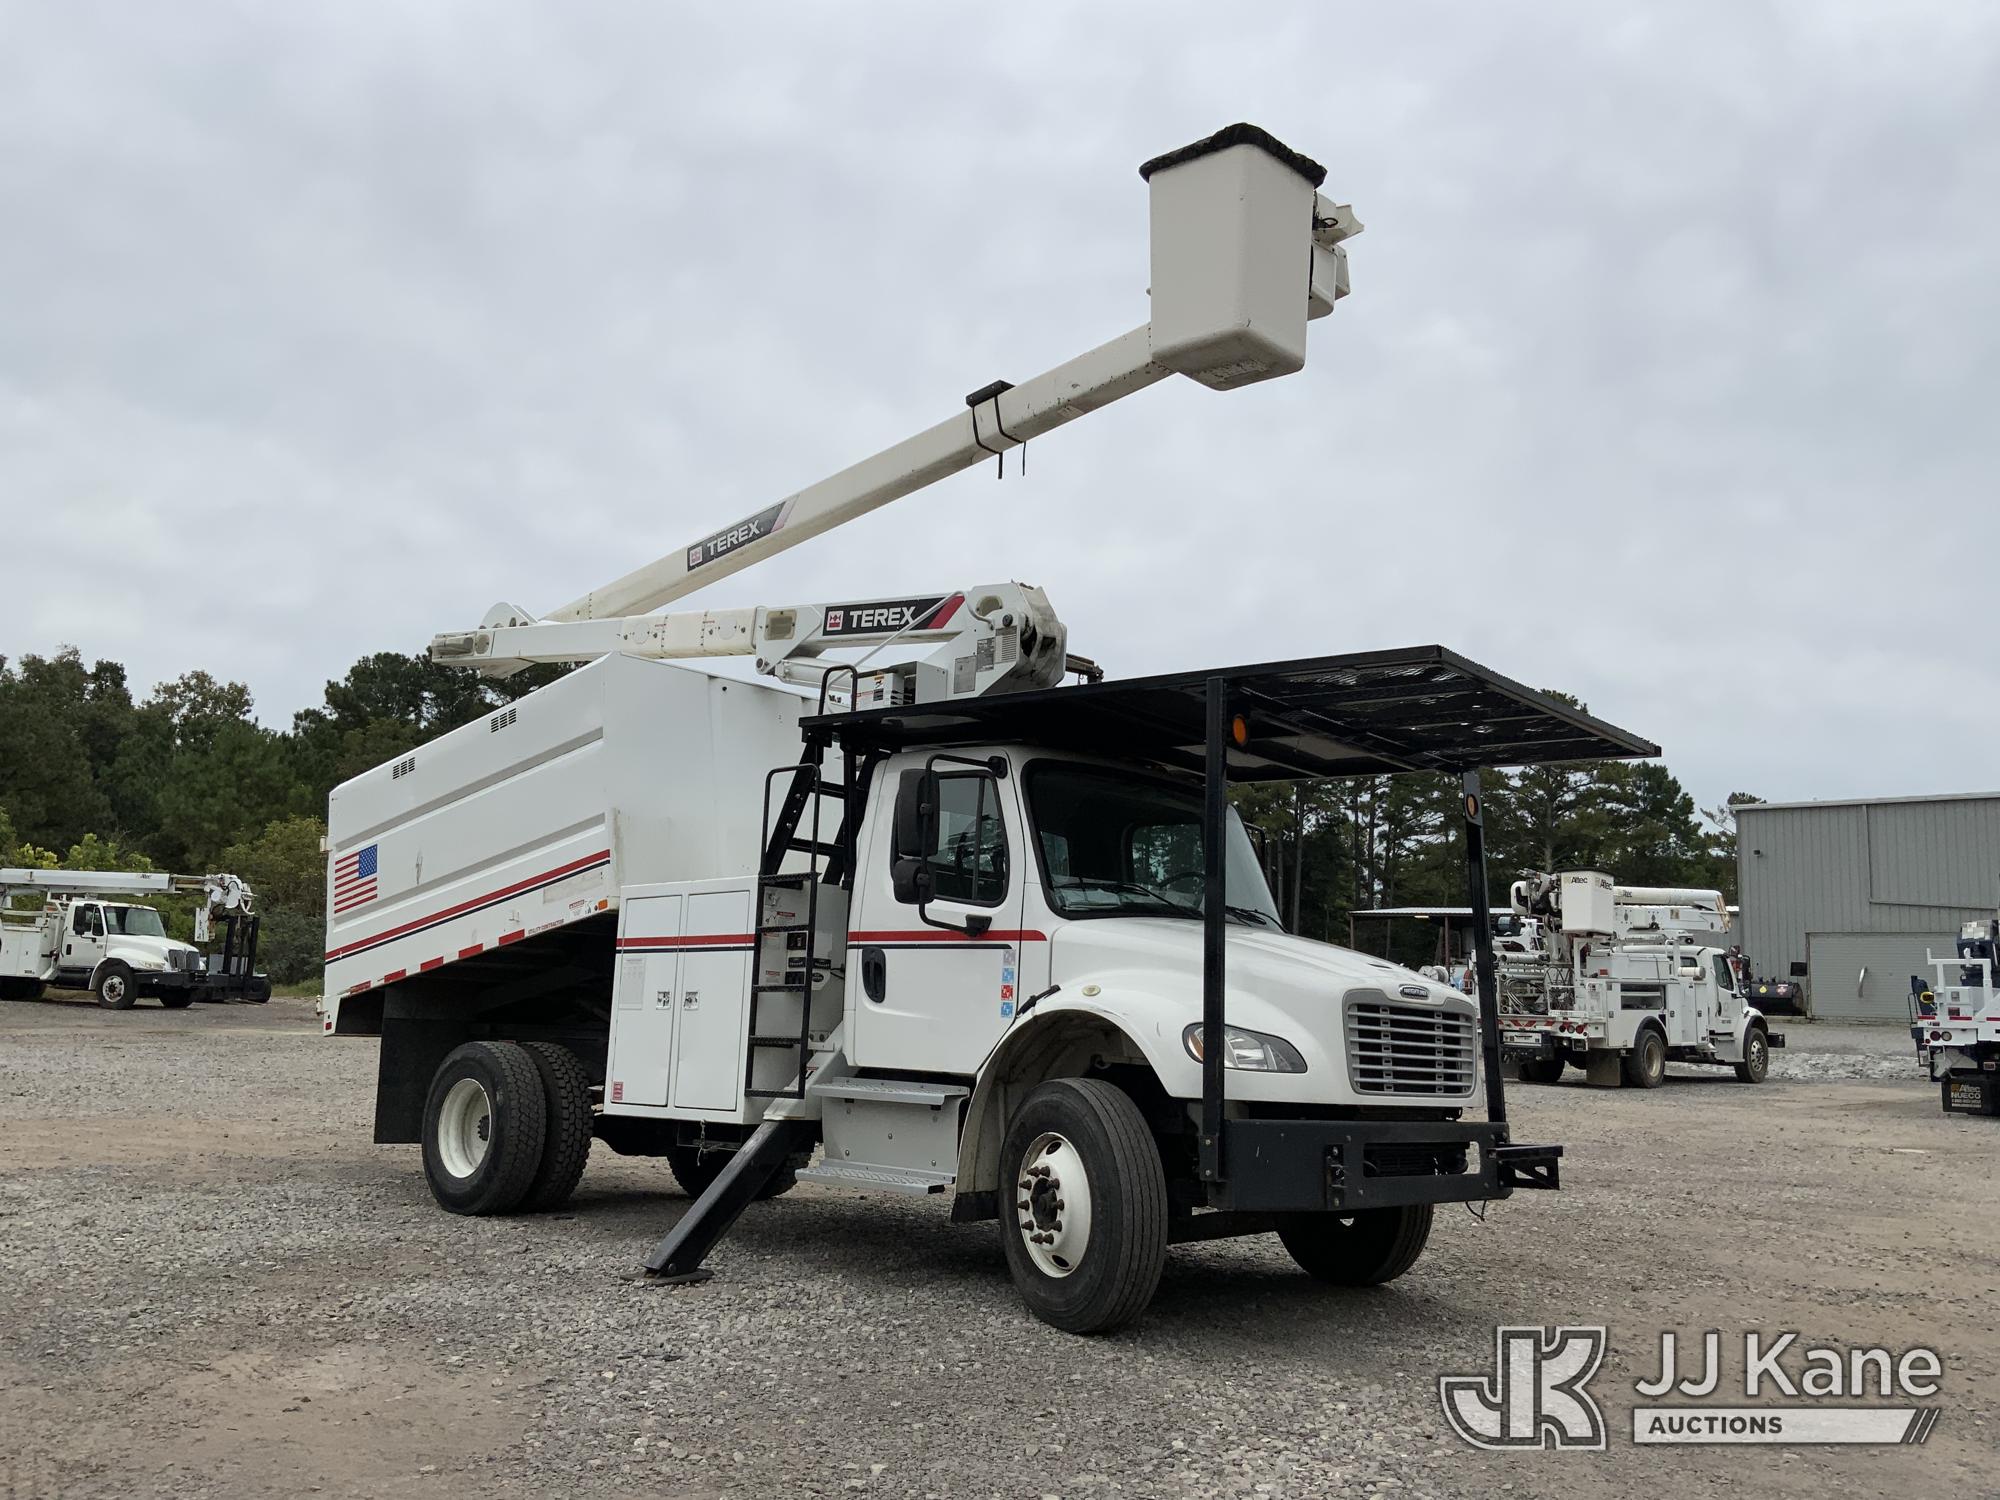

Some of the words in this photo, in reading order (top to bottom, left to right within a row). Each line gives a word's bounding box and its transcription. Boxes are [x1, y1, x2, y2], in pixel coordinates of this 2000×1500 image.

[707, 520, 760, 556] TEREX
[849, 606, 916, 628] TEREX
[1571, 876, 1588, 884] Altec
[1959, 1084, 1981, 1093] Altec
